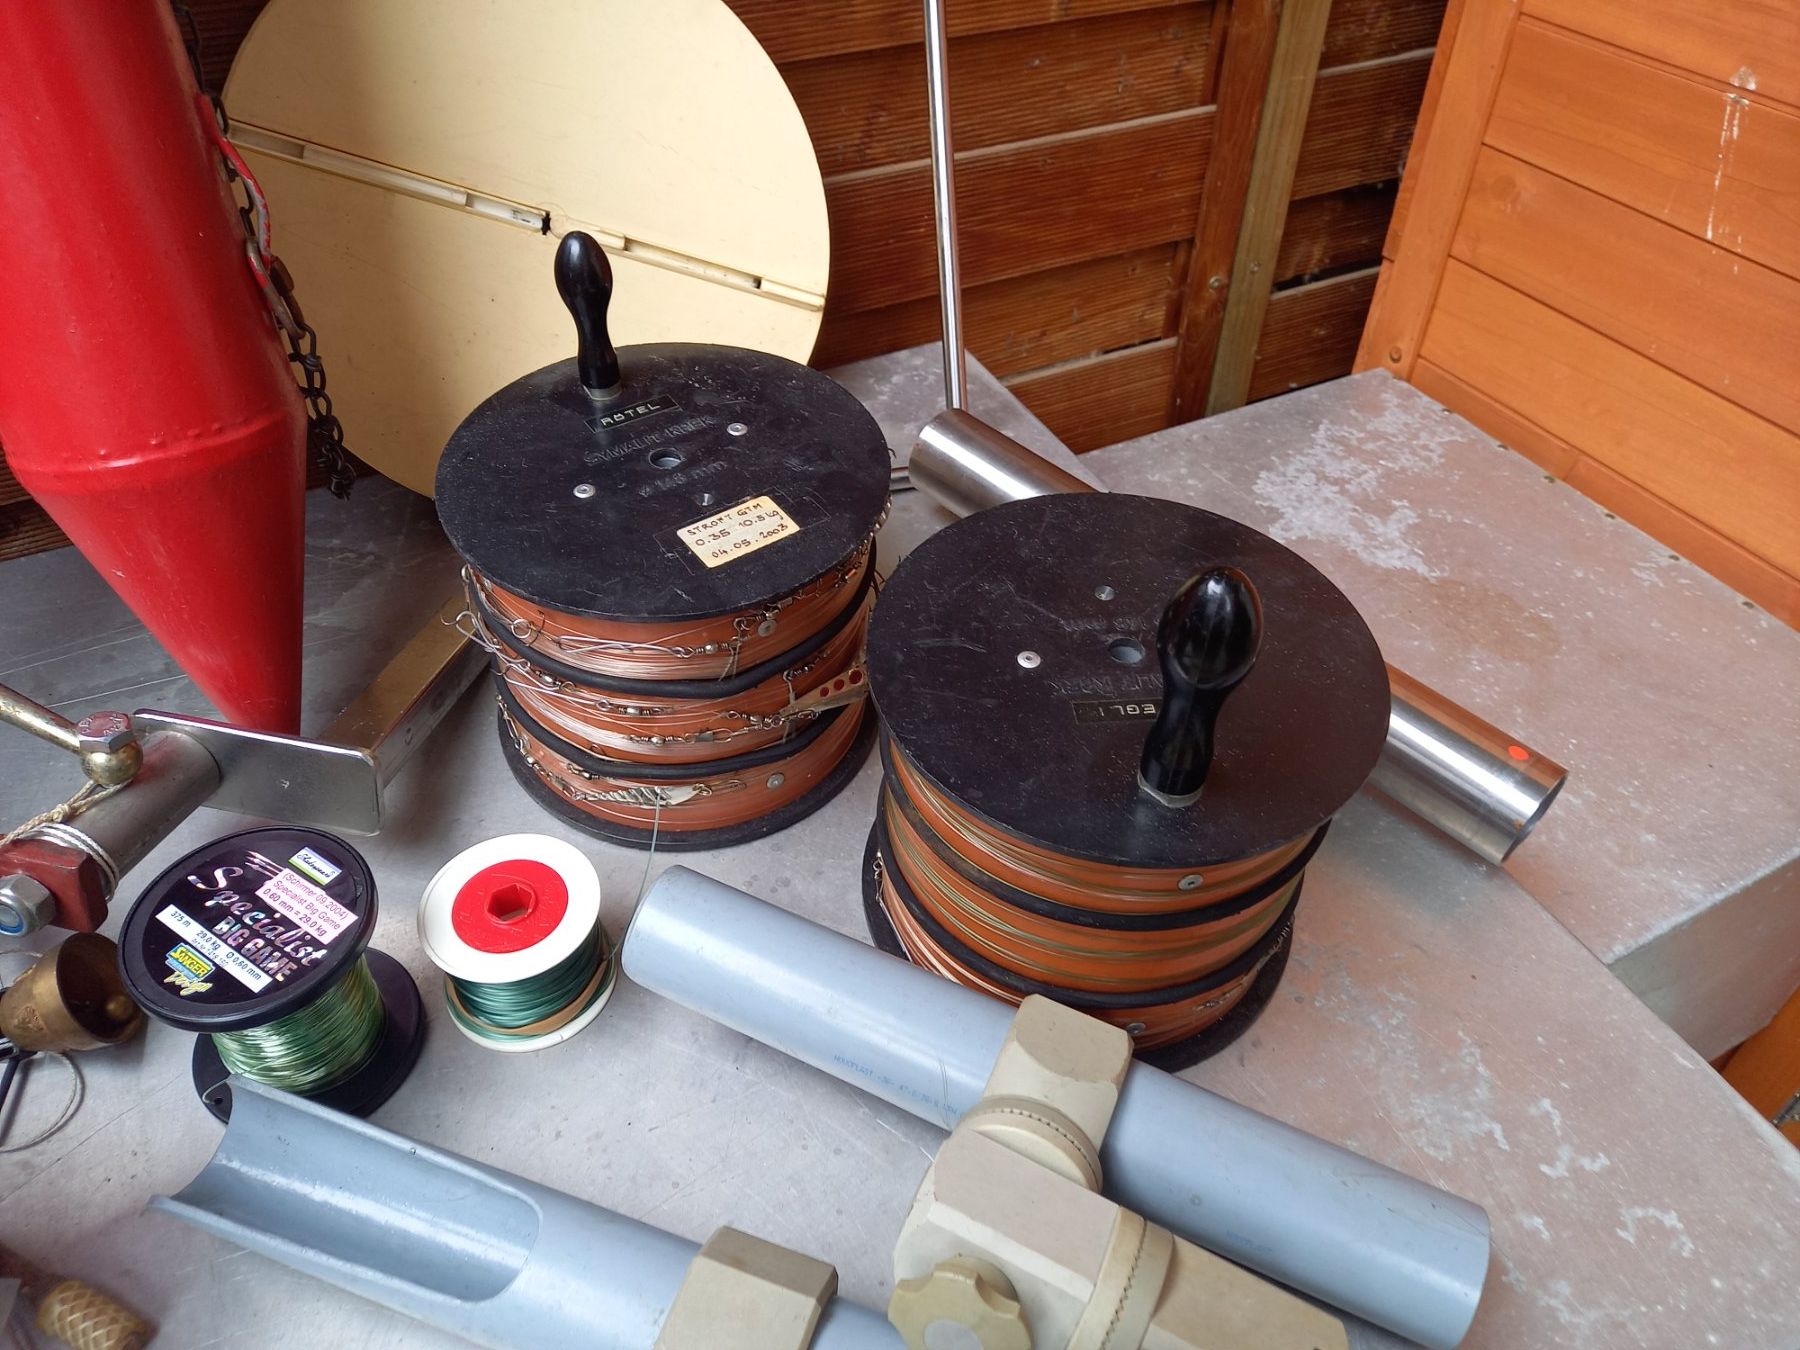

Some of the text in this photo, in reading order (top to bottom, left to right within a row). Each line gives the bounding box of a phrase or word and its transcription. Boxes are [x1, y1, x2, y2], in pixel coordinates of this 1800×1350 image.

[737, 502, 763, 517] GTM
[695, 528, 731, 547] 0.35
[1098, 703, 1157, 717] EGLI
[263, 888, 281, 903] 0.60
[279, 900, 294, 913] mm
[299, 913, 318, 928] 29.0
[315, 924, 327, 938] kg
[273, 880, 341, 931] Specialist Big Game
[315, 893, 349, 921] 09.2004)
[170, 911, 186, 923] 375
[187, 866, 328, 967] Specialist
[209, 940, 222, 953] kg
[212, 915, 251, 947] BIG
[240, 938, 298, 982] GAME
[245, 968, 262, 981] mm
